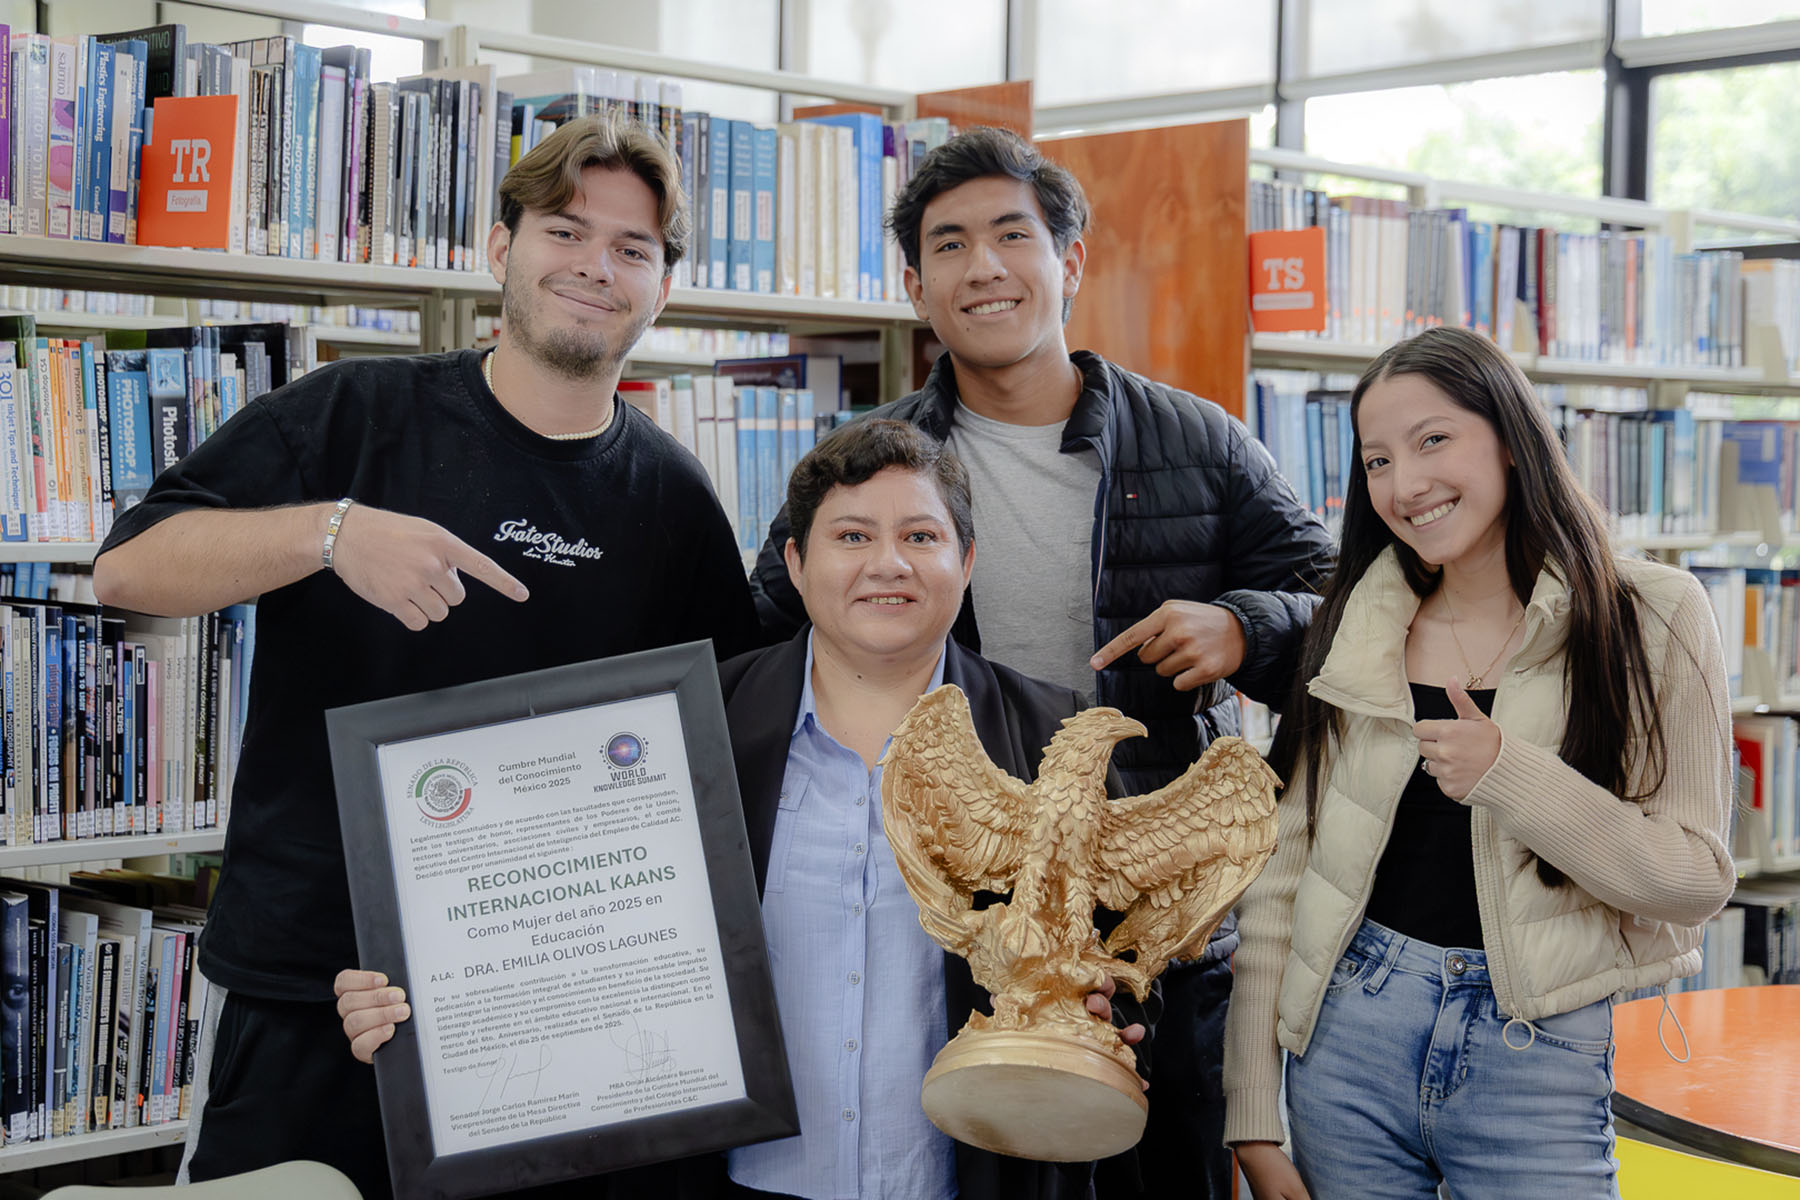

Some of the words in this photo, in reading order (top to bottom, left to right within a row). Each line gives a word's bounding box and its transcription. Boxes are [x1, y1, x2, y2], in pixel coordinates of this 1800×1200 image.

[98, 51, 110, 86] Plastics
[94, 87, 107, 142] Engineering
[170, 138, 212, 183] TR
[294, 134, 303, 217] PHOTOGRAPHY
[1263, 258, 1304, 290] TS
[0, 371, 13, 400] 301
[41, 374, 50, 416] Photoshop
[73, 368, 84, 422] Photoshop
[96, 365, 106, 422] PHOTOSHOP
[6, 404, 16, 428] Inkjet
[121, 379, 136, 467] PHOTOSHOP
[8, 430, 17, 445] Tips
[100, 434, 109, 458] TYPE
[10, 448, 19, 464] and
[11, 466, 20, 510] Techniques
[102, 460, 111, 490] MAGIC
[126, 470, 136, 480] 4
[494, 518, 603, 559] FateStudios
[46, 664, 61, 728] photography
[79, 680, 85, 689] TO
[48, 735, 59, 766] FOCUS
[498, 760, 536, 772] Cumbre
[537, 751, 576, 765] Mundial
[49, 767, 59, 782] ON
[498, 775, 513, 784] del
[515, 763, 581, 781] Conocimiento
[513, 782, 546, 794] México
[548, 776, 570, 787] 2025
[593, 778, 636, 792] KNOWLEDGE
[637, 772, 666, 785] SUMMIT
[610, 767, 646, 782] WORLD
[49, 783, 59, 814] PROFIT
[445, 837, 474, 846] testigos
[516, 818, 570, 832] representantes
[600, 807, 629, 816] Poderes
[467, 846, 647, 892] RECONOCIMIENTO
[447, 879, 606, 921] INTERNACIONAL
[610, 865, 676, 890] KAANS
[467, 923, 509, 939] Como
[512, 915, 551, 930] Mujer
[554, 908, 577, 922] del
[580, 904, 605, 918] año
[608, 896, 642, 912] 2025
[645, 894, 662, 905] en
[531, 923, 604, 946] Educación
[464, 962, 498, 978] DRA.
[502, 952, 550, 970] EMILIA
[552, 940, 606, 960] OLIVOS
[609, 927, 677, 950] LAGUNES
[84, 964, 93, 990] Visual
[139, 959, 147, 988] Visual
[439, 971, 454, 980] LA:
[82, 992, 90, 1021] Story
[136, 990, 145, 1014] Story
[454, 1008, 481, 1018] integrar
[491, 999, 531, 1011] innovación
[546, 987, 596, 1000] conocimiento
[608, 978, 642, 989] beneficio
[662, 967, 695, 978] sociedad.
[498, 1027, 541, 1039] Aniversario,
[544, 1019, 578, 1030] realizada
[602, 1009, 630, 1019] Senado
[654, 998, 691, 1008] República
[451, 1116, 506, 1130] Vicepresidente
[547, 1101, 580, 1112] Directiva
